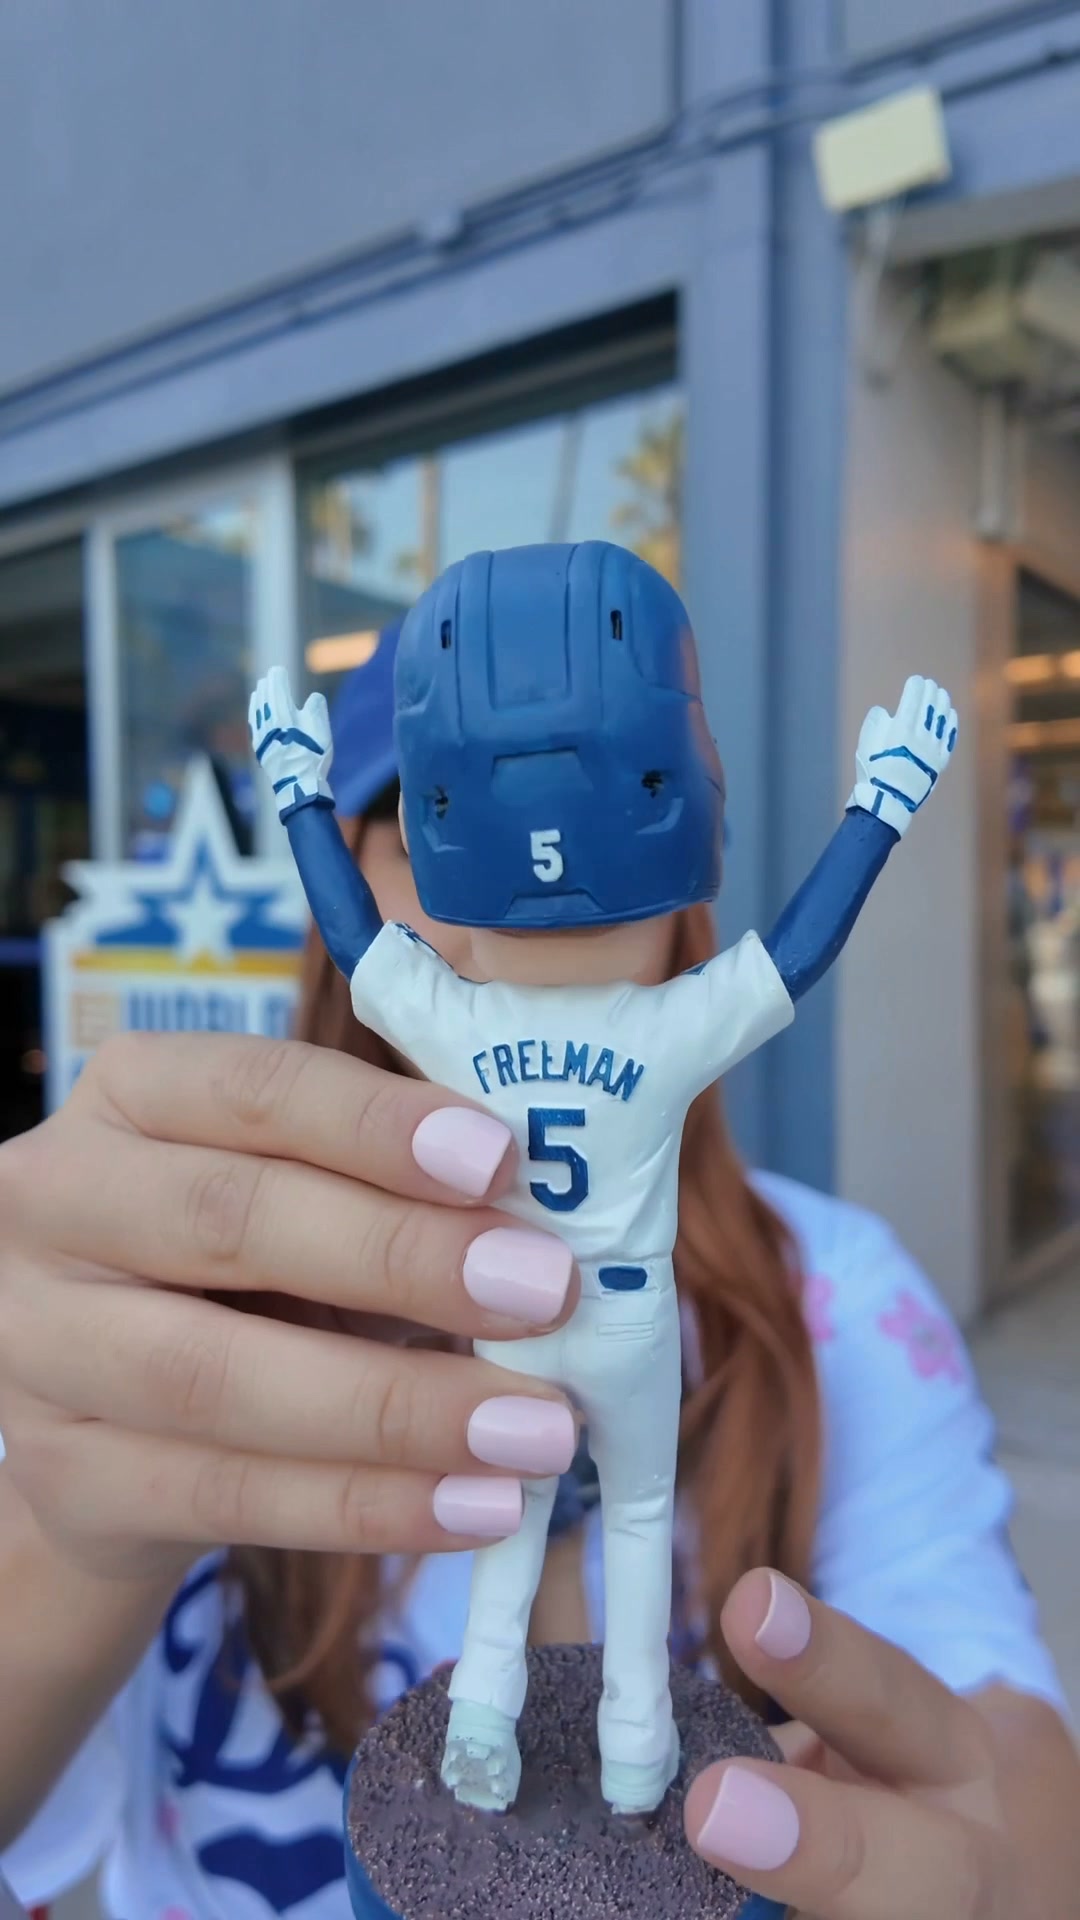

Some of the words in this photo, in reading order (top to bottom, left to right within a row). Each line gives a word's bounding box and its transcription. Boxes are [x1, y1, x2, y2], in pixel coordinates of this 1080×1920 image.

[530, 829, 563, 882] 5
[472, 1039, 645, 1102] FREEMAN
[527, 1107, 590, 1212] 5
